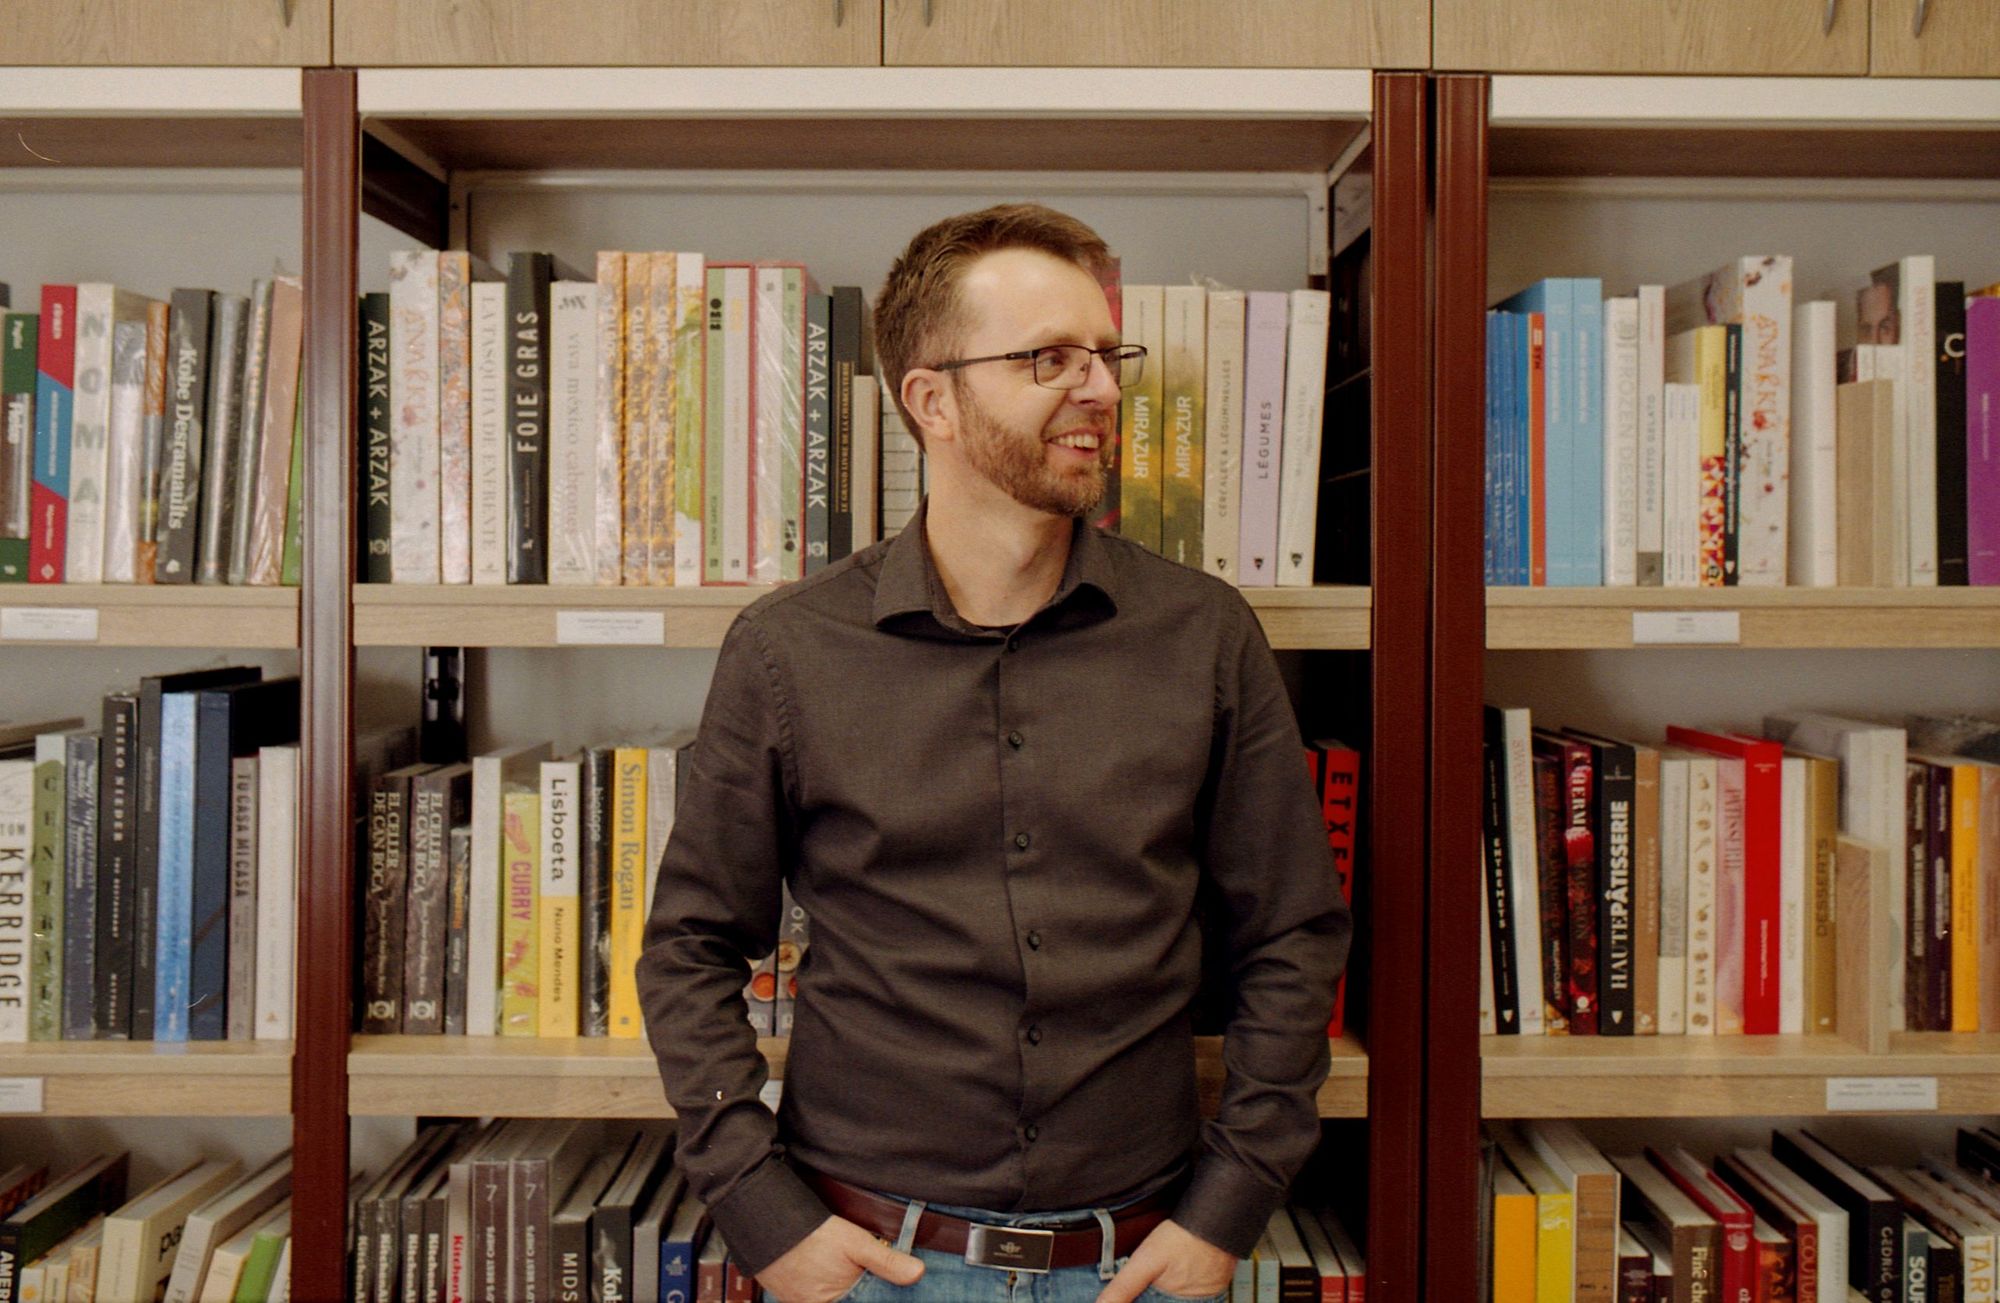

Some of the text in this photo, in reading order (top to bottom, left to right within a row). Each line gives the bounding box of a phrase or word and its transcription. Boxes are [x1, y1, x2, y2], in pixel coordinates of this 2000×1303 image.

[517, 311, 539, 377] GRAS
[567, 332, 582, 371] viva
[167, 348, 198, 529] Kobe Desramaults
[369, 320, 387, 506] ARZAK + ARZAK
[481, 424, 500, 451] DE
[517, 394, 538, 453] FOIE
[808, 322, 826, 508] ARZAK + ARZAK
[1133, 396, 1150, 479] MIRAZUR
[1175, 396, 1192, 478] MIRAZUR
[1255, 401, 1273, 480] LÉGUMES
[1616, 354, 1634, 548] FROZEN DESSERTS
[481, 455, 500, 552] ENFRENTE
[113, 713, 126, 842] HEIKO NIEDER
[374, 791, 387, 814] DE
[416, 791, 430, 814] DE
[235, 774, 252, 898] TU CASA MI CASA
[373, 816, 386, 849] CAN
[387, 792, 401, 869] EL CELLER
[415, 816, 429, 849] CAN
[429, 792, 444, 869] EL CELLER
[551, 778, 568, 881] Lisboeta
[615, 763, 642, 911] Simon Rogan
[1328, 771, 1354, 887] ETXE
[371, 851, 385, 894] ROCA
[413, 851, 428, 894] ROCA
[511, 861, 533, 921] CURRY
[1604, 800, 1629, 990] HAUTEPÂTISSERIE
[1815, 837, 1828, 938] DESSERTS
[0, 848, 25, 1010] KERRIDGE
[553, 907, 565, 1003] Nuno Mendes
[487, 1184, 498, 1202] 7
[526, 1184, 537, 1200] 7
